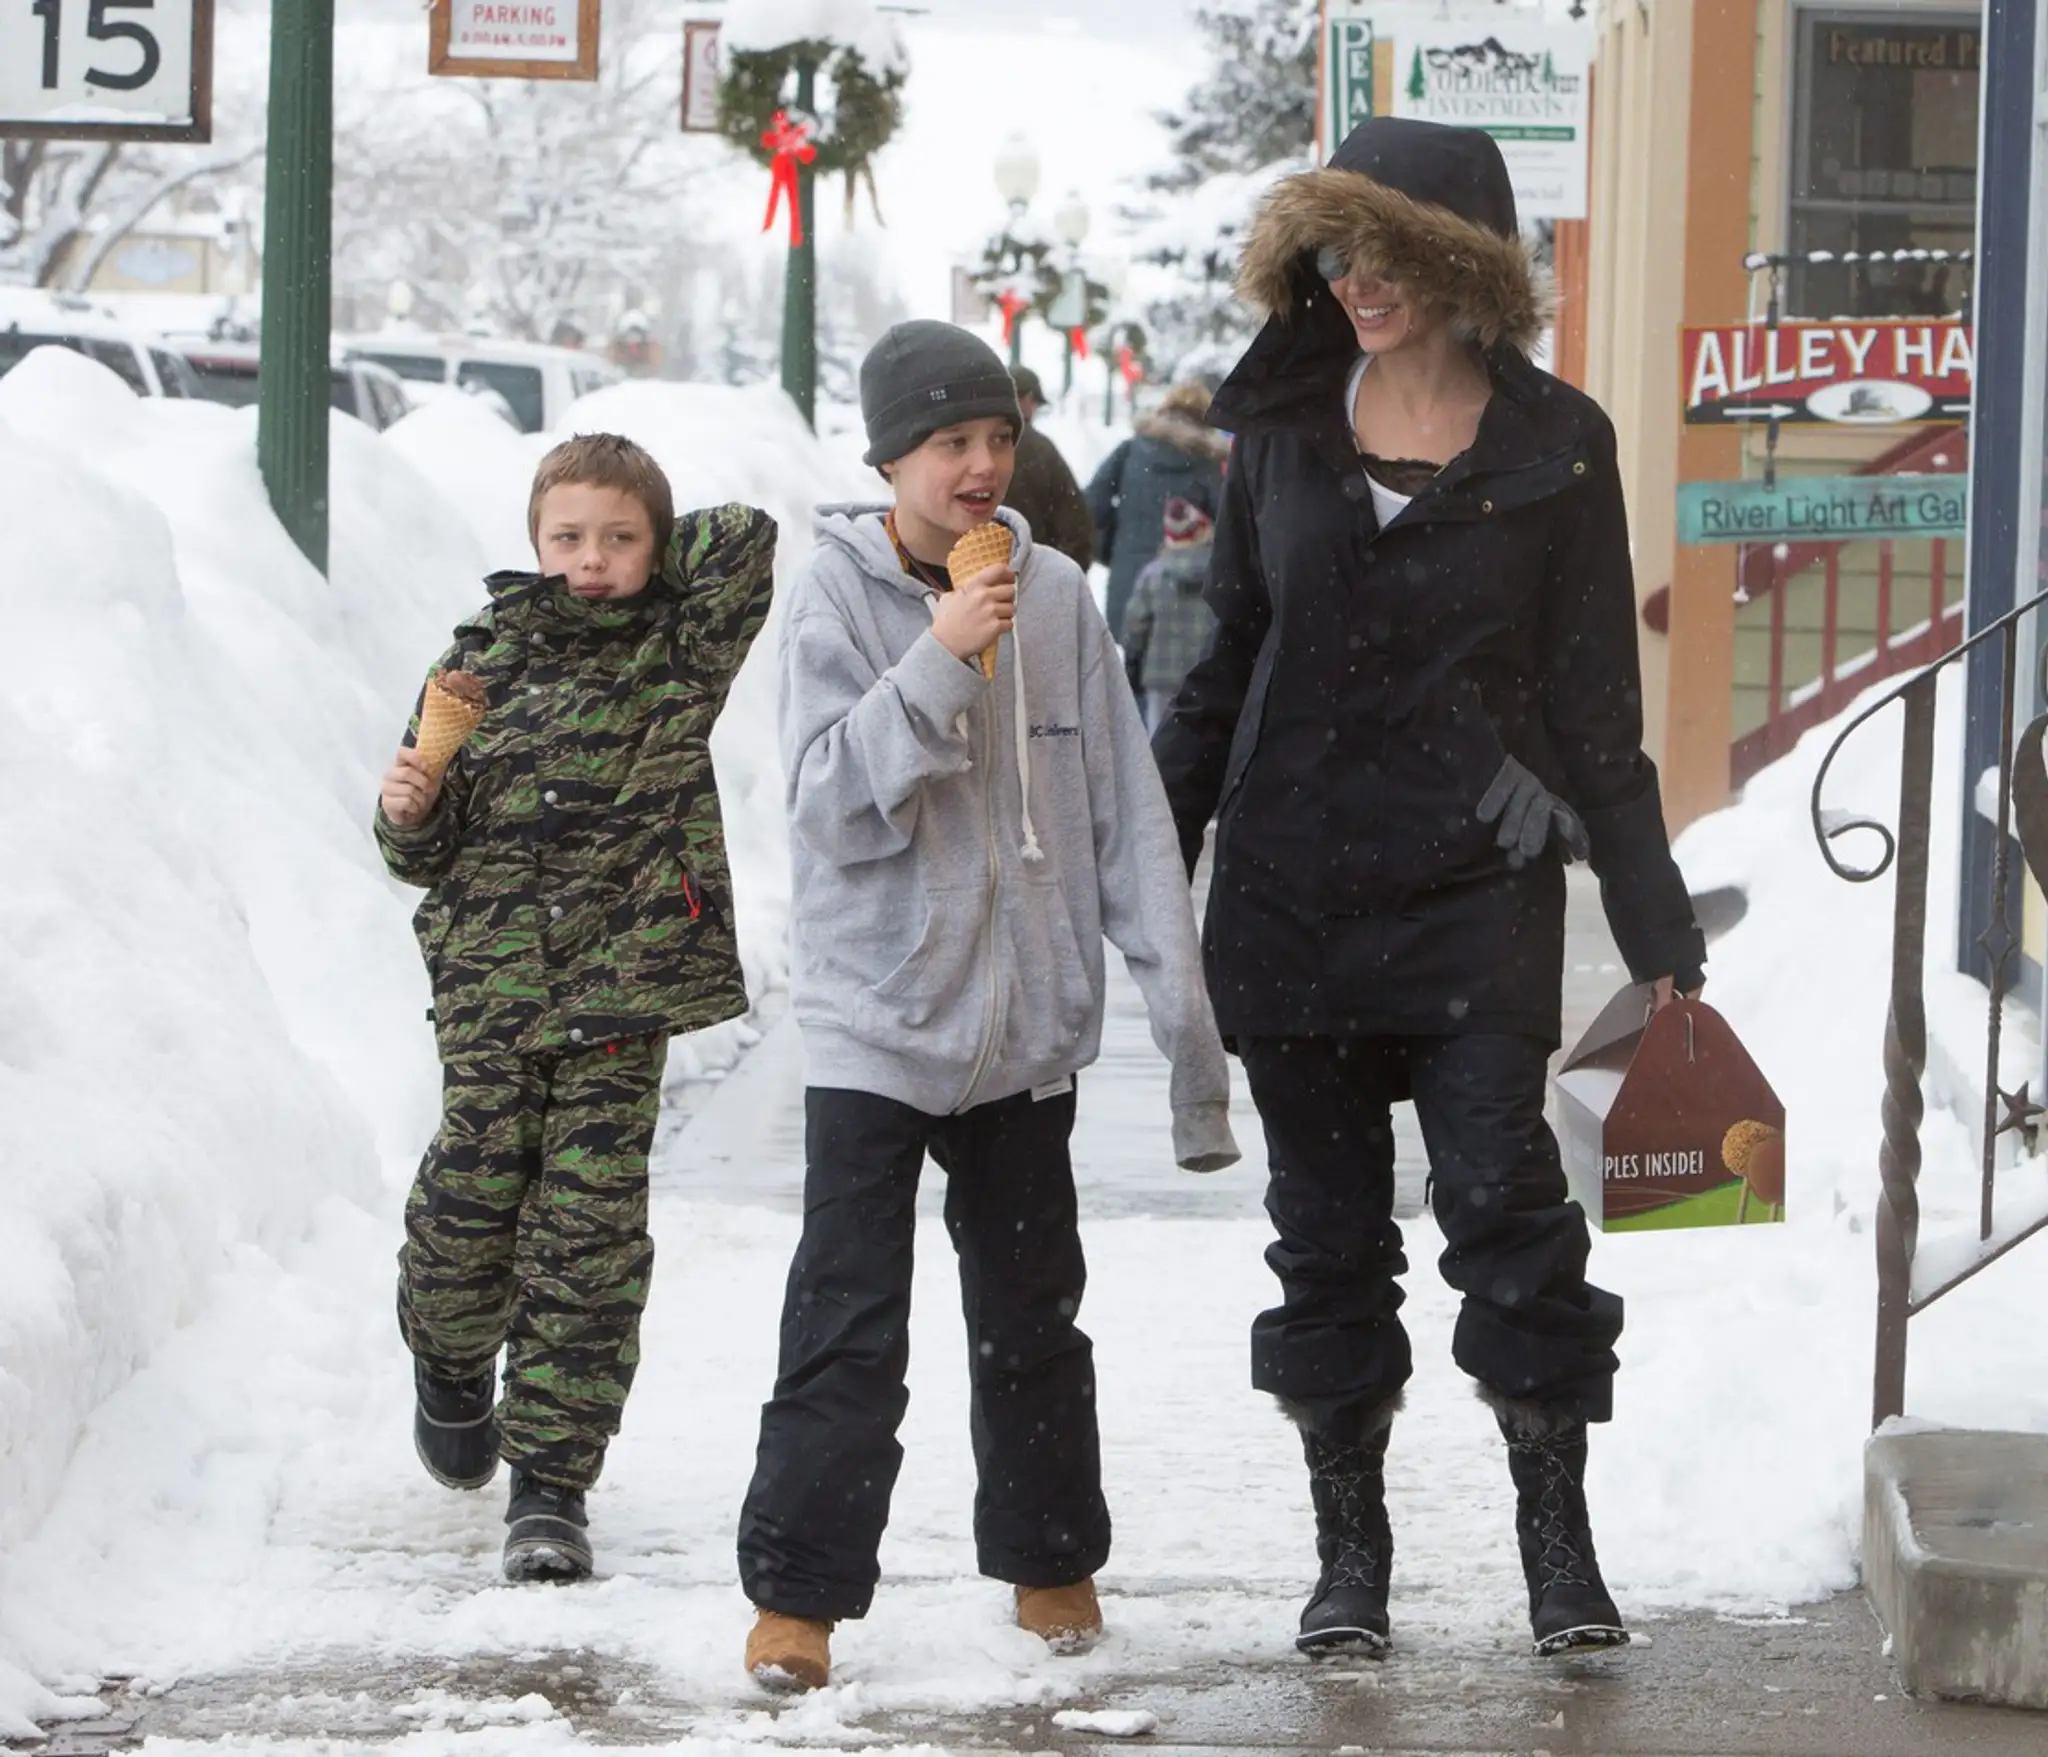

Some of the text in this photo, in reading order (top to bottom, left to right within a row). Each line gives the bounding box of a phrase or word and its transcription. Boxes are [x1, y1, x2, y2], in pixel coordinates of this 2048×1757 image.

[472, 3, 556, 26] PARKING
[32, 0, 161, 91] 15
[1829, 30, 1946, 66] Featured
[1333, 20, 1372, 134] PEA
[1688, 327, 1972, 409] ALLEY HA
[1702, 498, 1777, 530] River
[1786, 494, 1859, 534] Light
[1867, 494, 1906, 526] Art
[1645, 1150, 1704, 1177] INSIDE!
